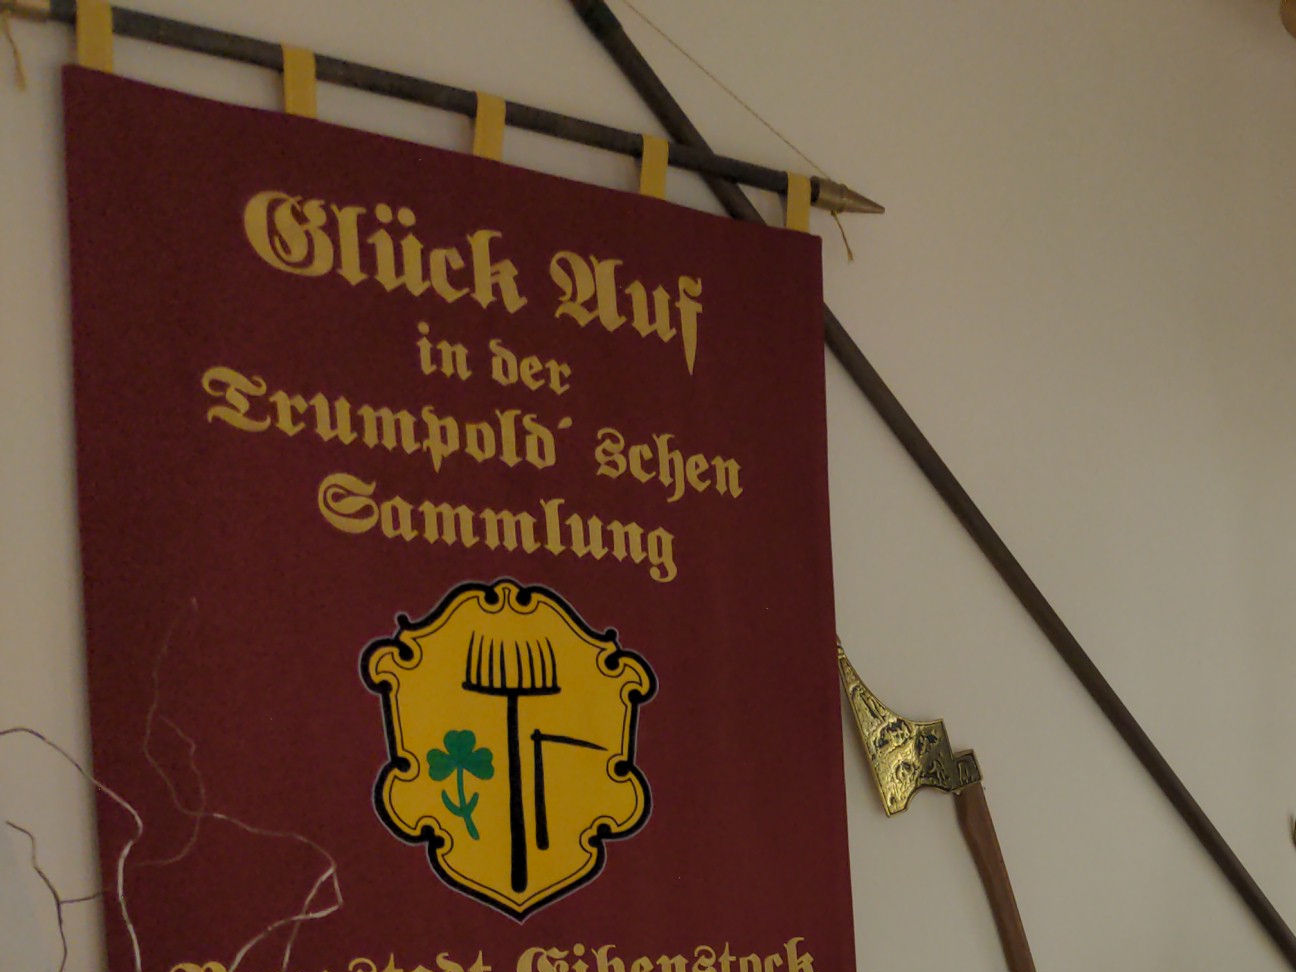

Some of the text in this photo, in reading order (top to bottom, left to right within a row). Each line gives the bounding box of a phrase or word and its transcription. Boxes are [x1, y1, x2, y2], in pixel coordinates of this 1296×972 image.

[243, 190, 702, 375] Glück Auf
[417, 321, 571, 395] in der
[595, 428, 743, 503] schen
[318, 472, 677, 582] Sammlung
